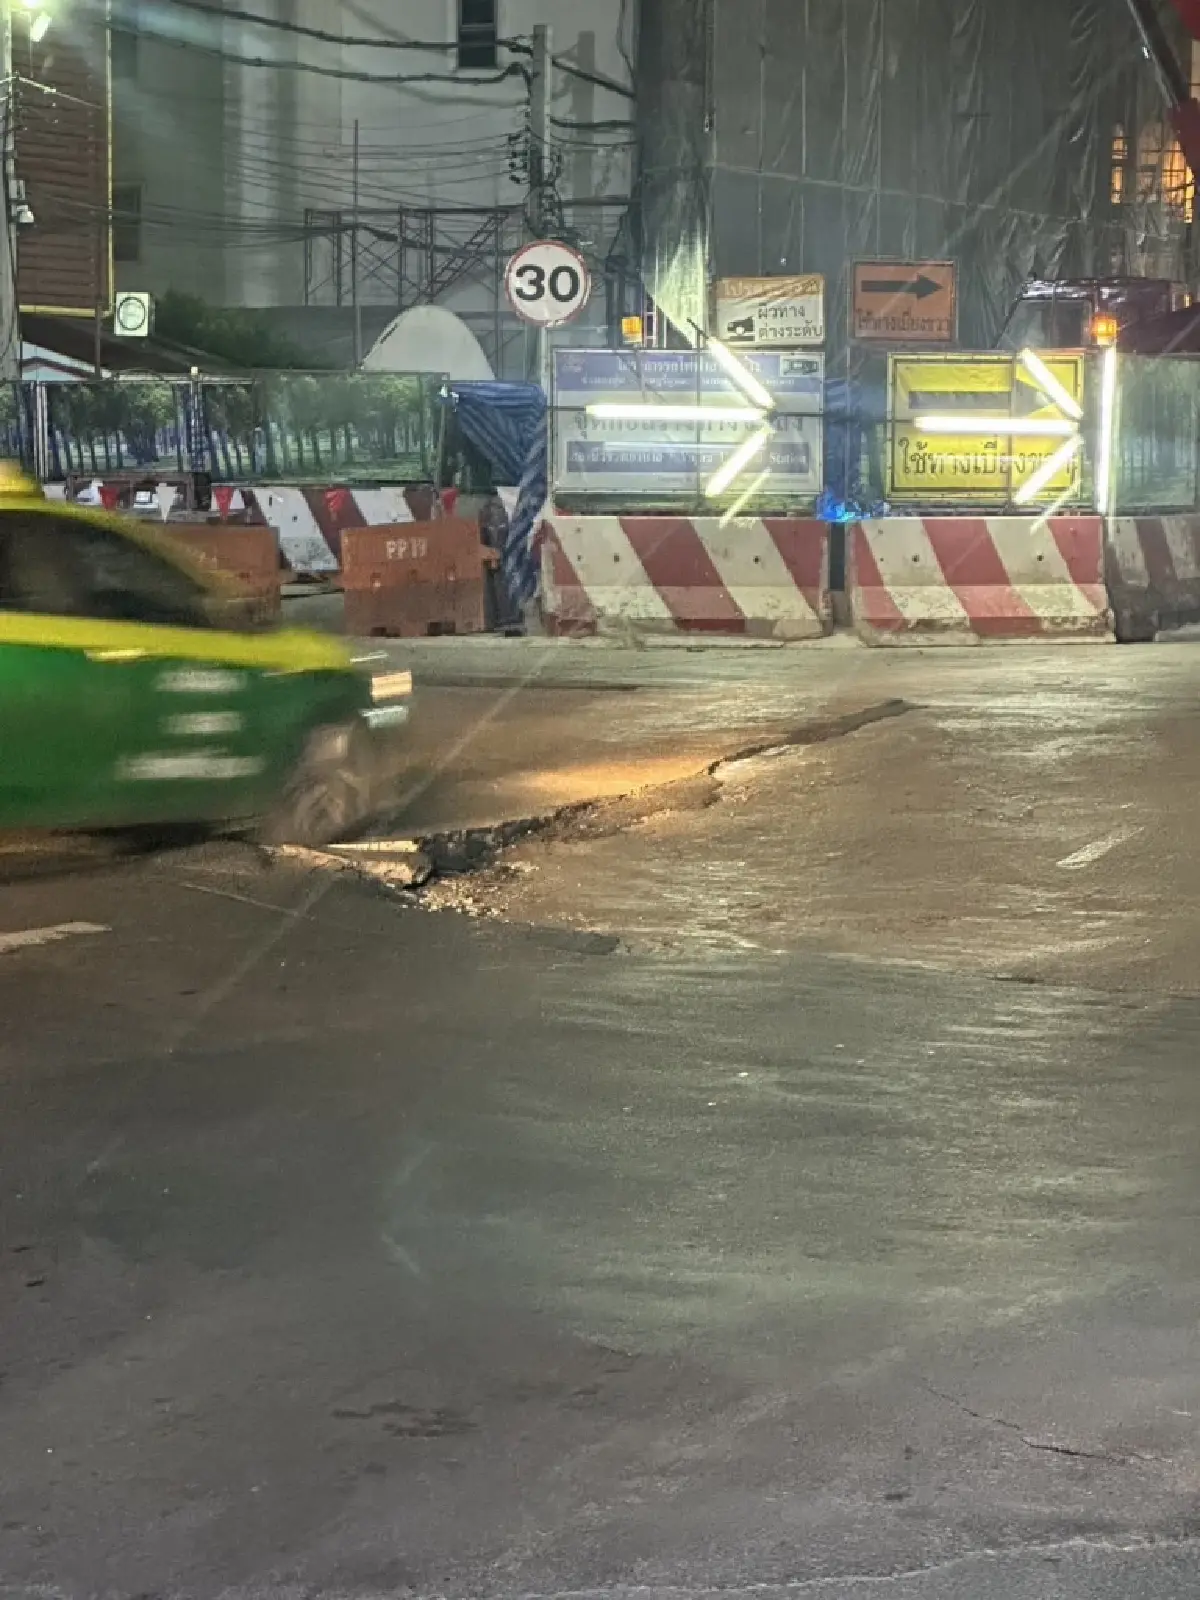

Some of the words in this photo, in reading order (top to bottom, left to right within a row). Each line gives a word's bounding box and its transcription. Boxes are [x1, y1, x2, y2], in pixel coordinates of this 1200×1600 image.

[515, 265, 577, 300] 30
[758, 320, 823, 339] ต่างระดับ
